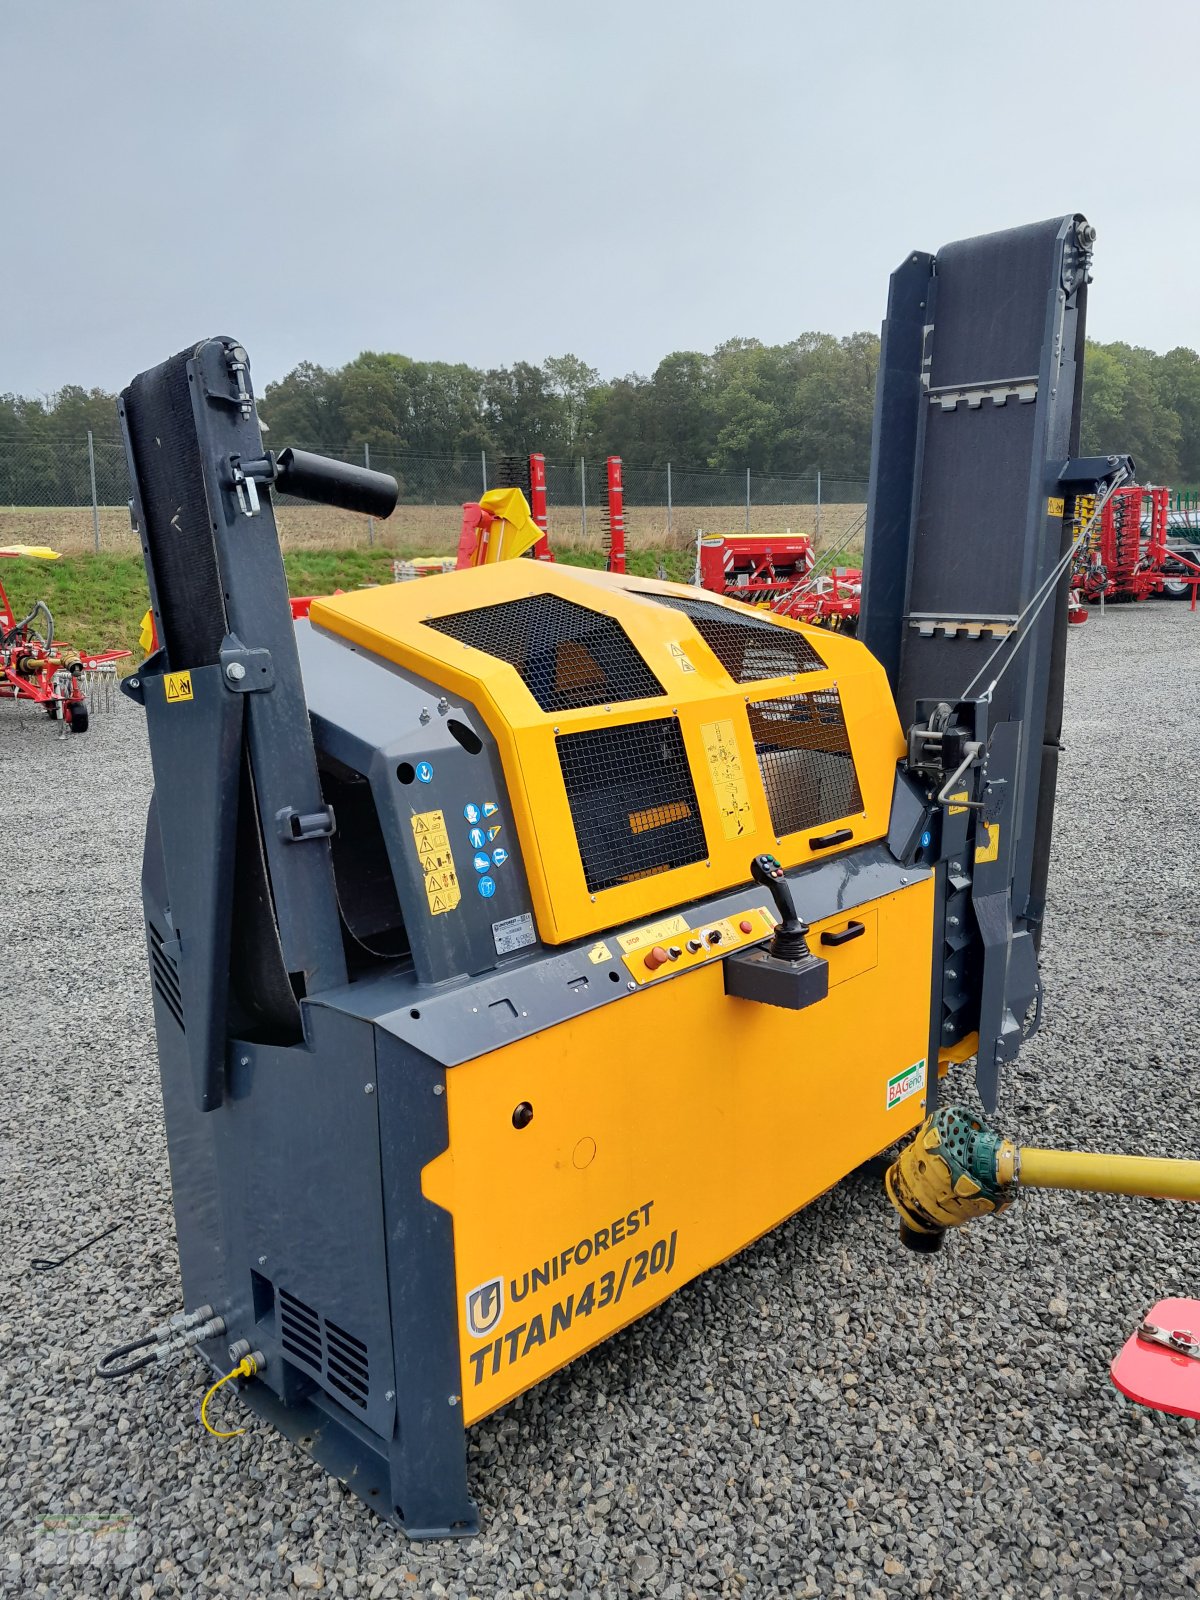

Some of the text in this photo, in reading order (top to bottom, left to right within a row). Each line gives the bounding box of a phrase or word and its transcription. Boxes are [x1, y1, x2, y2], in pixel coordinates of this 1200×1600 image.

[626, 936, 640, 946] STOP
[889, 1075, 922, 1102] BAGeno
[510, 1200, 654, 1303] UNIFOREST
